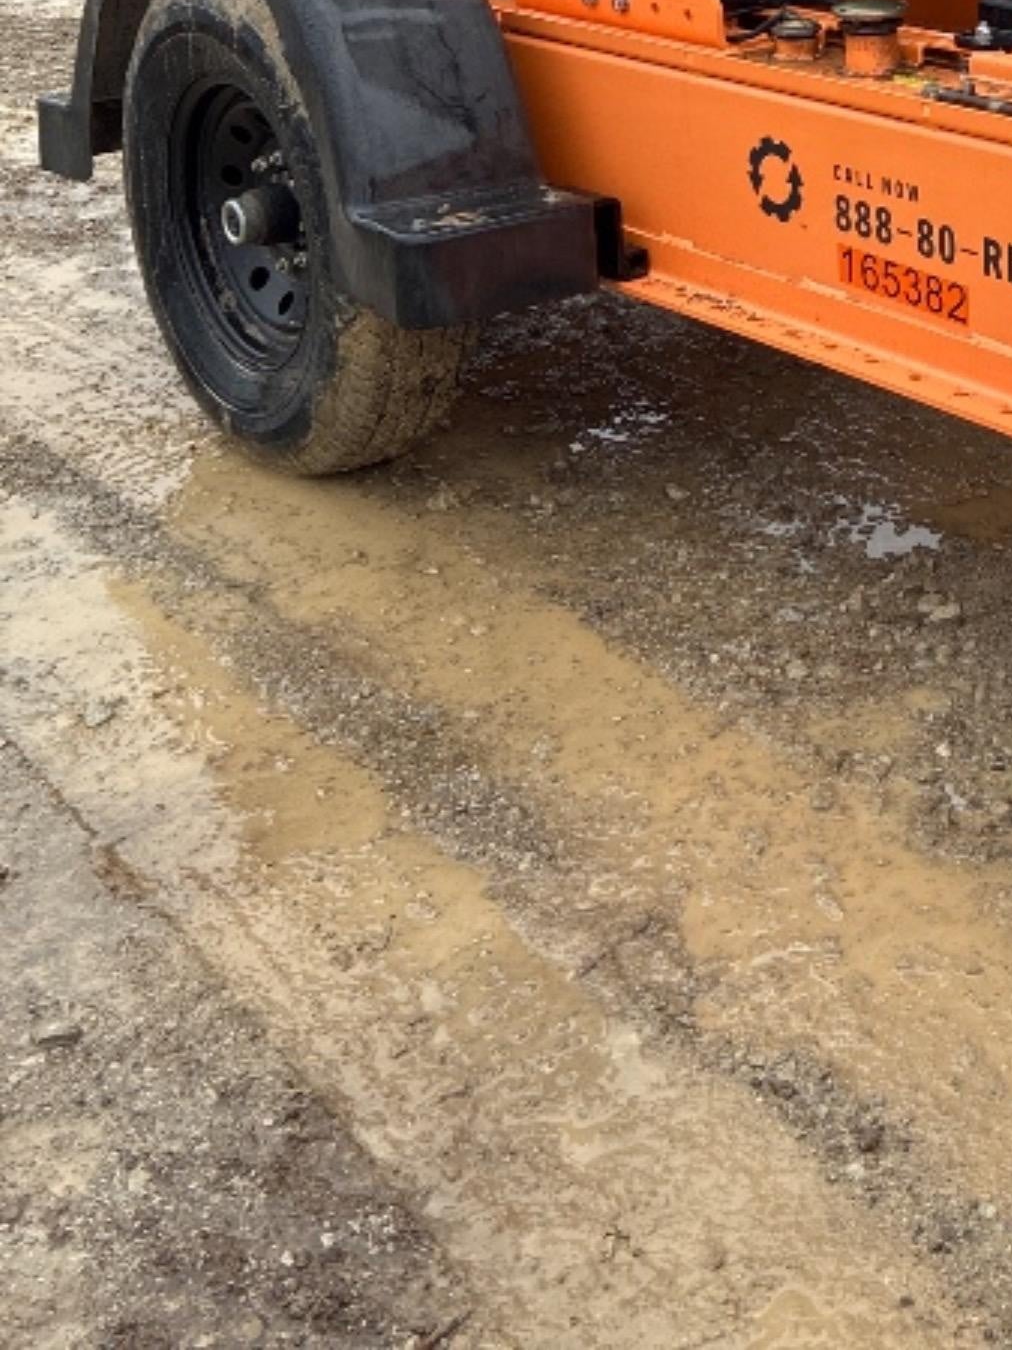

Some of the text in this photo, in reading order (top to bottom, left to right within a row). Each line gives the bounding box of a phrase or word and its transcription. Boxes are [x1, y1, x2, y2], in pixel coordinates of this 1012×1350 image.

[833, 164, 919, 202] CALL NOW
[842, 248, 968, 325] 165382
